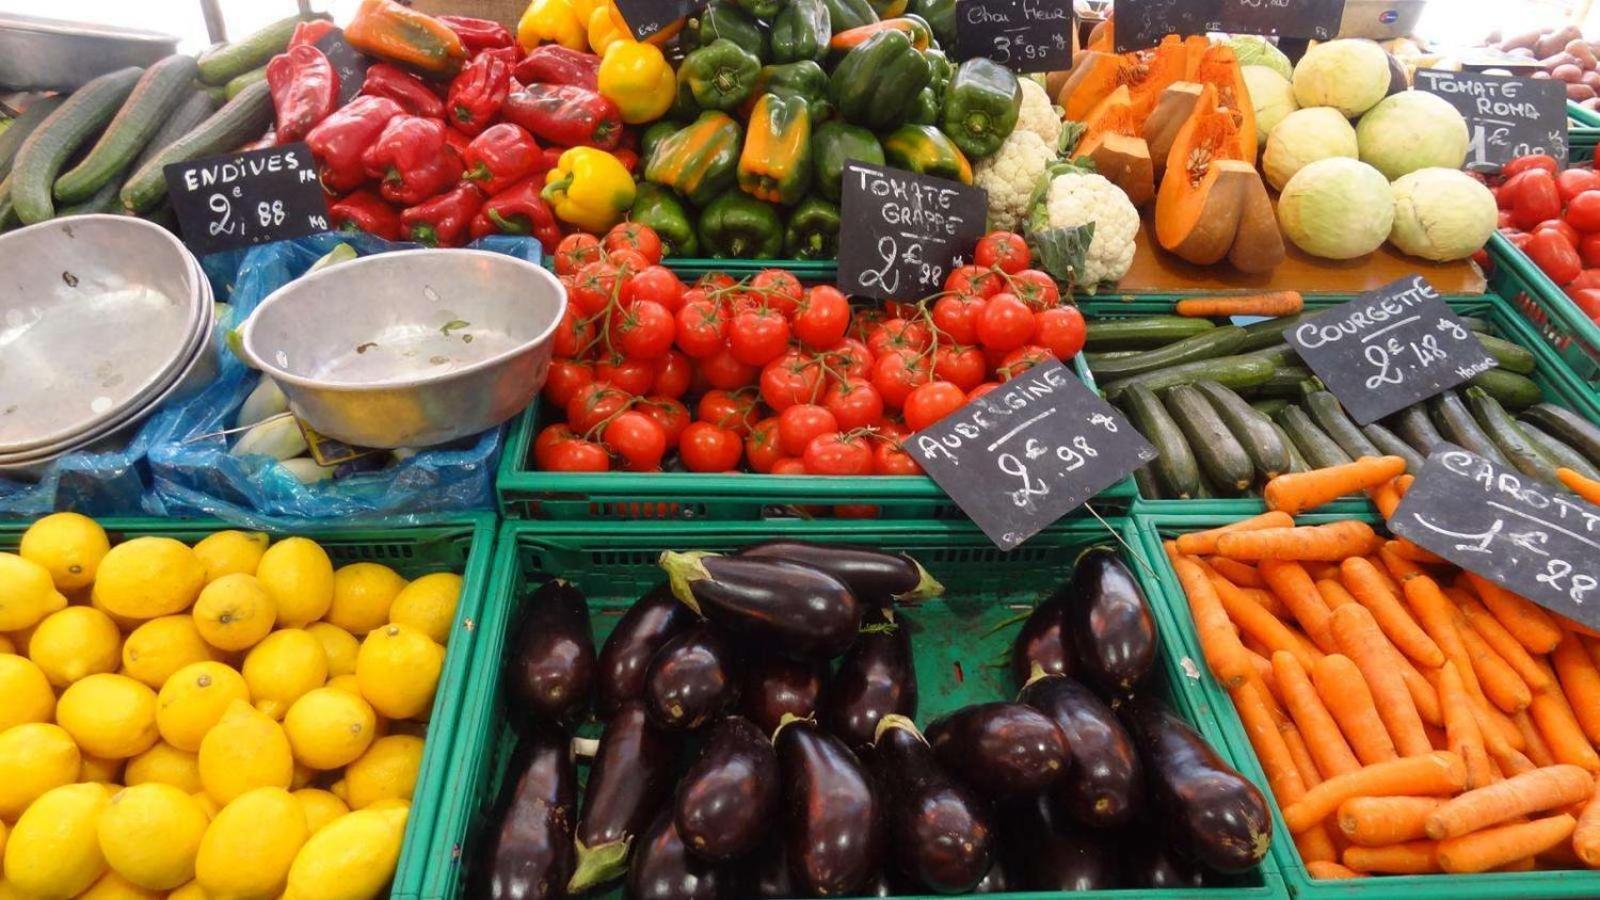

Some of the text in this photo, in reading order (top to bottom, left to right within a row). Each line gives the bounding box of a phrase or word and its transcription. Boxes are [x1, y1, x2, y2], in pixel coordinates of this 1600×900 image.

[1418, 70, 1524, 98] TOMATE
[1476, 97, 1541, 120] ROMA
[849, 165, 960, 210] TOMATE
[881, 202, 964, 236] GRAPPE
[1296, 276, 1439, 349] COURGETTE
